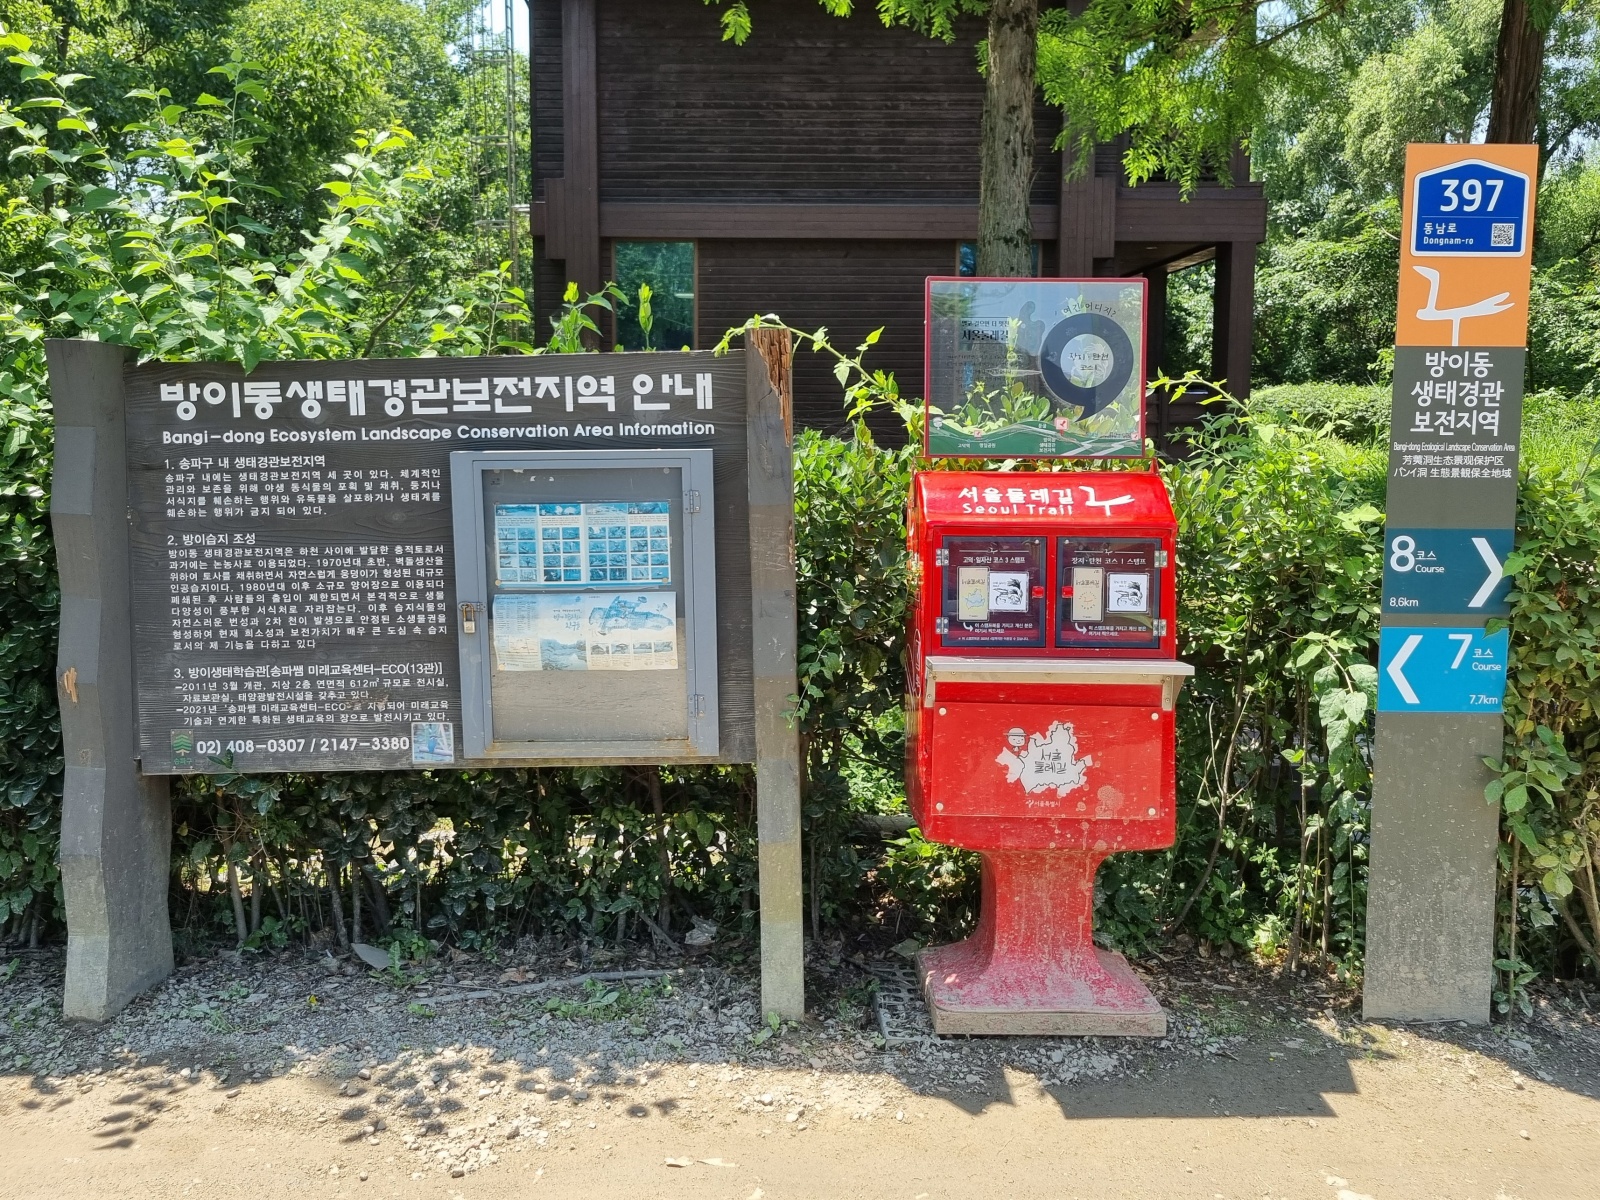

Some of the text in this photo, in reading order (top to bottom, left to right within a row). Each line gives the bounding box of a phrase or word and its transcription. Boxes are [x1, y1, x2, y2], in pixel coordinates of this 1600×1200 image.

[1439, 178, 1504, 213] 397
[1423, 222, 1457, 234] 동남로
[1423, 236, 1474, 246] Dongnam-ro
[1425, 351, 1493, 377] 방이동
[160, 373, 713, 421] 방이동생태경관보전지역 안내
[1411, 380, 1504, 407] 생태경관
[1410, 409, 1500, 436] 보전지역
[162, 421, 715, 444] Bangi-dong Ecosystem Landscape Conservation Area Information
[1393, 442, 1515, 452] Bangi-dong Ecological Landscape Conservation Area
[164, 454, 325, 470] 1. 송파구 내 생태경관보전지역
[164, 468, 440, 483] 송파구 내에는 생태경관보전지역 세 곳이 있다. 체계적인
[165, 479, 440, 494] 관리와 보존을 위해 야생 동식물의 포획 및 채취, 둥지나
[165, 491, 440, 506] 서식지를 훼손하는 행위와 유독물을 살포하거나 생태계를
[958, 487, 1074, 505] 서울둘레길
[166, 505, 326, 518] 훼손하는 행위가 금지 되어 있다.
[962, 502, 1073, 516] Seoul Trail
[167, 532, 256, 546] 2. 방이습지 조성
[168, 543, 443, 559] 방이동 생태경관보전지역은 하천 사이에 발달한 충적토로서
[1390, 535, 1437, 572] 8 코스
[168, 555, 444, 570] 과거에는 논농사로 이용되었다. 1970년대 초반, 벽돌생산을
[1415, 565, 1445, 573] Course
[1389, 597, 1418, 607] 8.6km
[172, 625, 447, 640] 형성하여 현재 희소성과 보전가치가 매우 큰 도심 속 습지
[172, 638, 316, 651] 로서의 제 기능을 다하고 있다
[1448, 634, 1494, 669] 7 코스
[173, 667, 184, 679] 3.
[308, 661, 442, 678] 미래교육센터-ECO(13관)]
[1472, 662, 1501, 671] Course
[222, 681, 238, 691] 3월
[243, 680, 266, 690] 개관,
[271, 679, 290, 690] 지상
[295, 679, 311, 689] 2층
[316, 679, 344, 690] 연면적
[382, 678, 411, 687] 규모로
[416, 677, 448, 687] 전시실,
[183, 690, 373, 703] 자료보관실, 태양광발전시설을 갖추고 있다.
[1469, 695, 1498, 705] 7.7km
[410, 700, 449, 711] 미래교육
[183, 711, 449, 726] 기술과 연계한 특화된 생태교육의 장으로 발전시키고 있다.
[196, 739, 221, 755] 02)
[226, 739, 306, 754] 408-0307
[320, 737, 410, 752] 2147-3380
[1040, 749, 1062, 761] 서울
[1034, 761, 1067, 774] 둘레길
